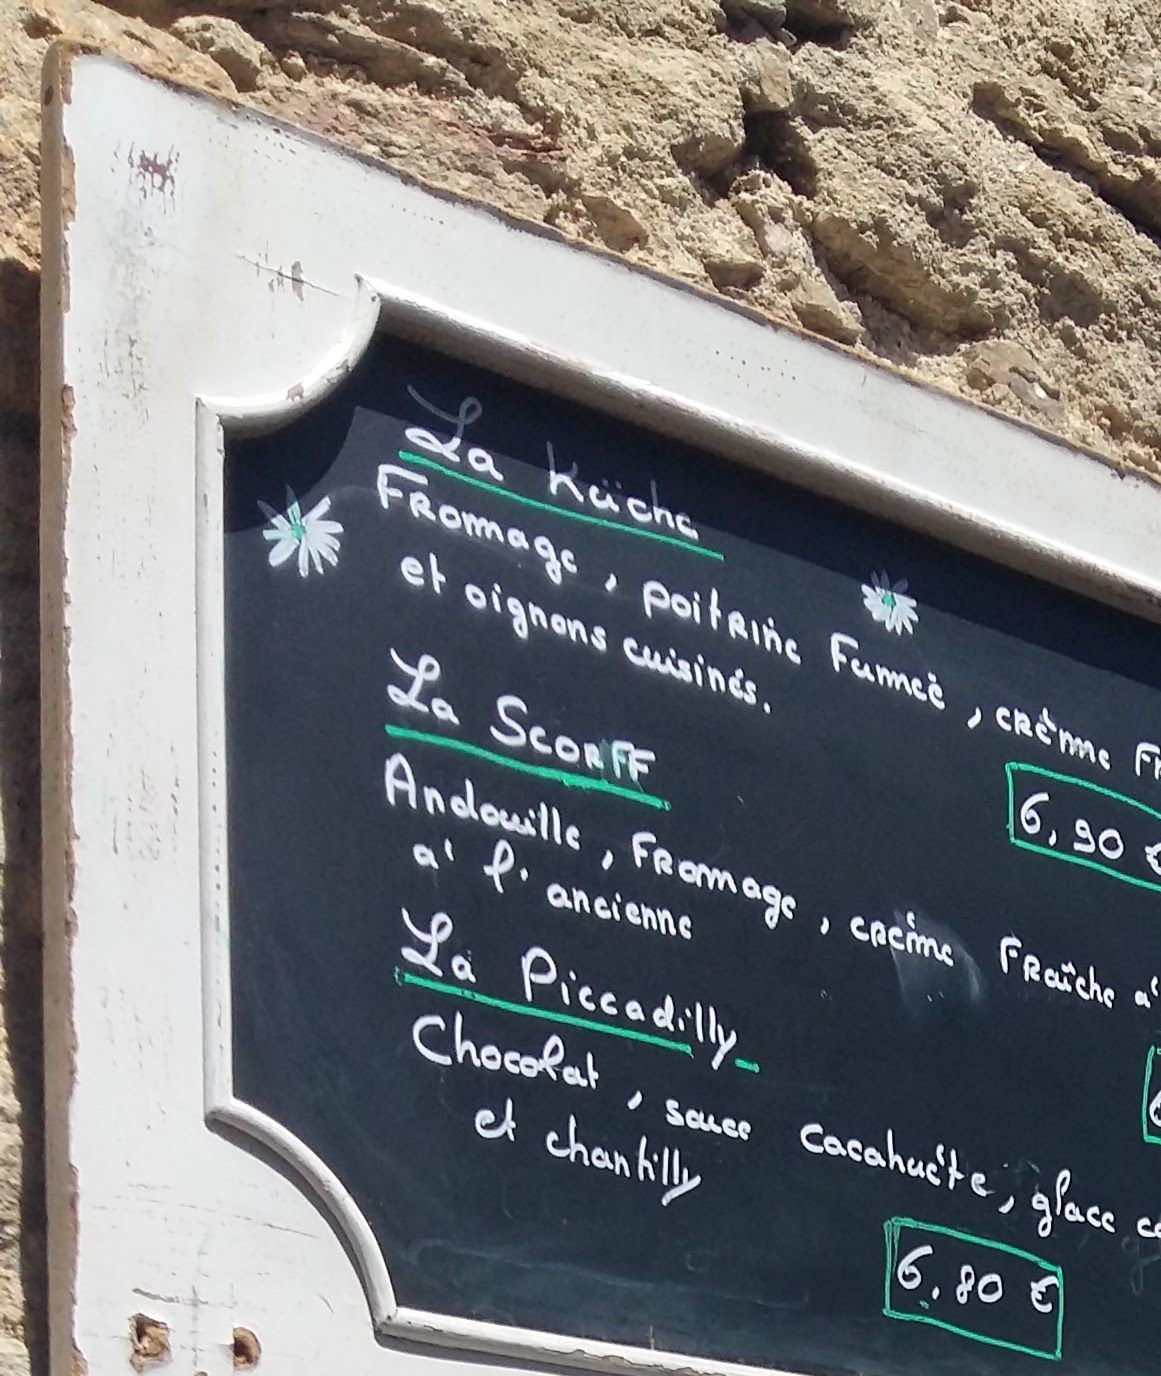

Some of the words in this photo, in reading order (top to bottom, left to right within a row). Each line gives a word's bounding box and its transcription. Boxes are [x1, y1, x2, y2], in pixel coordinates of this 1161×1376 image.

[404, 384, 505, 481] La
[400, 550, 447, 595] et
[464, 582, 608, 652] oignons
[386, 647, 461, 725] La
[384, 754, 582, 852] Andouille
[400, 906, 477, 984] La
[519, 944, 738, 1071] Piccadilly
[411, 1011, 600, 1089] Chocolat
[665, 1099, 753, 1142] sauce
[1031, 1169, 1117, 1239] glace
[474, 1099, 517, 1142] et
[546, 1114, 702, 1206] chantilly
